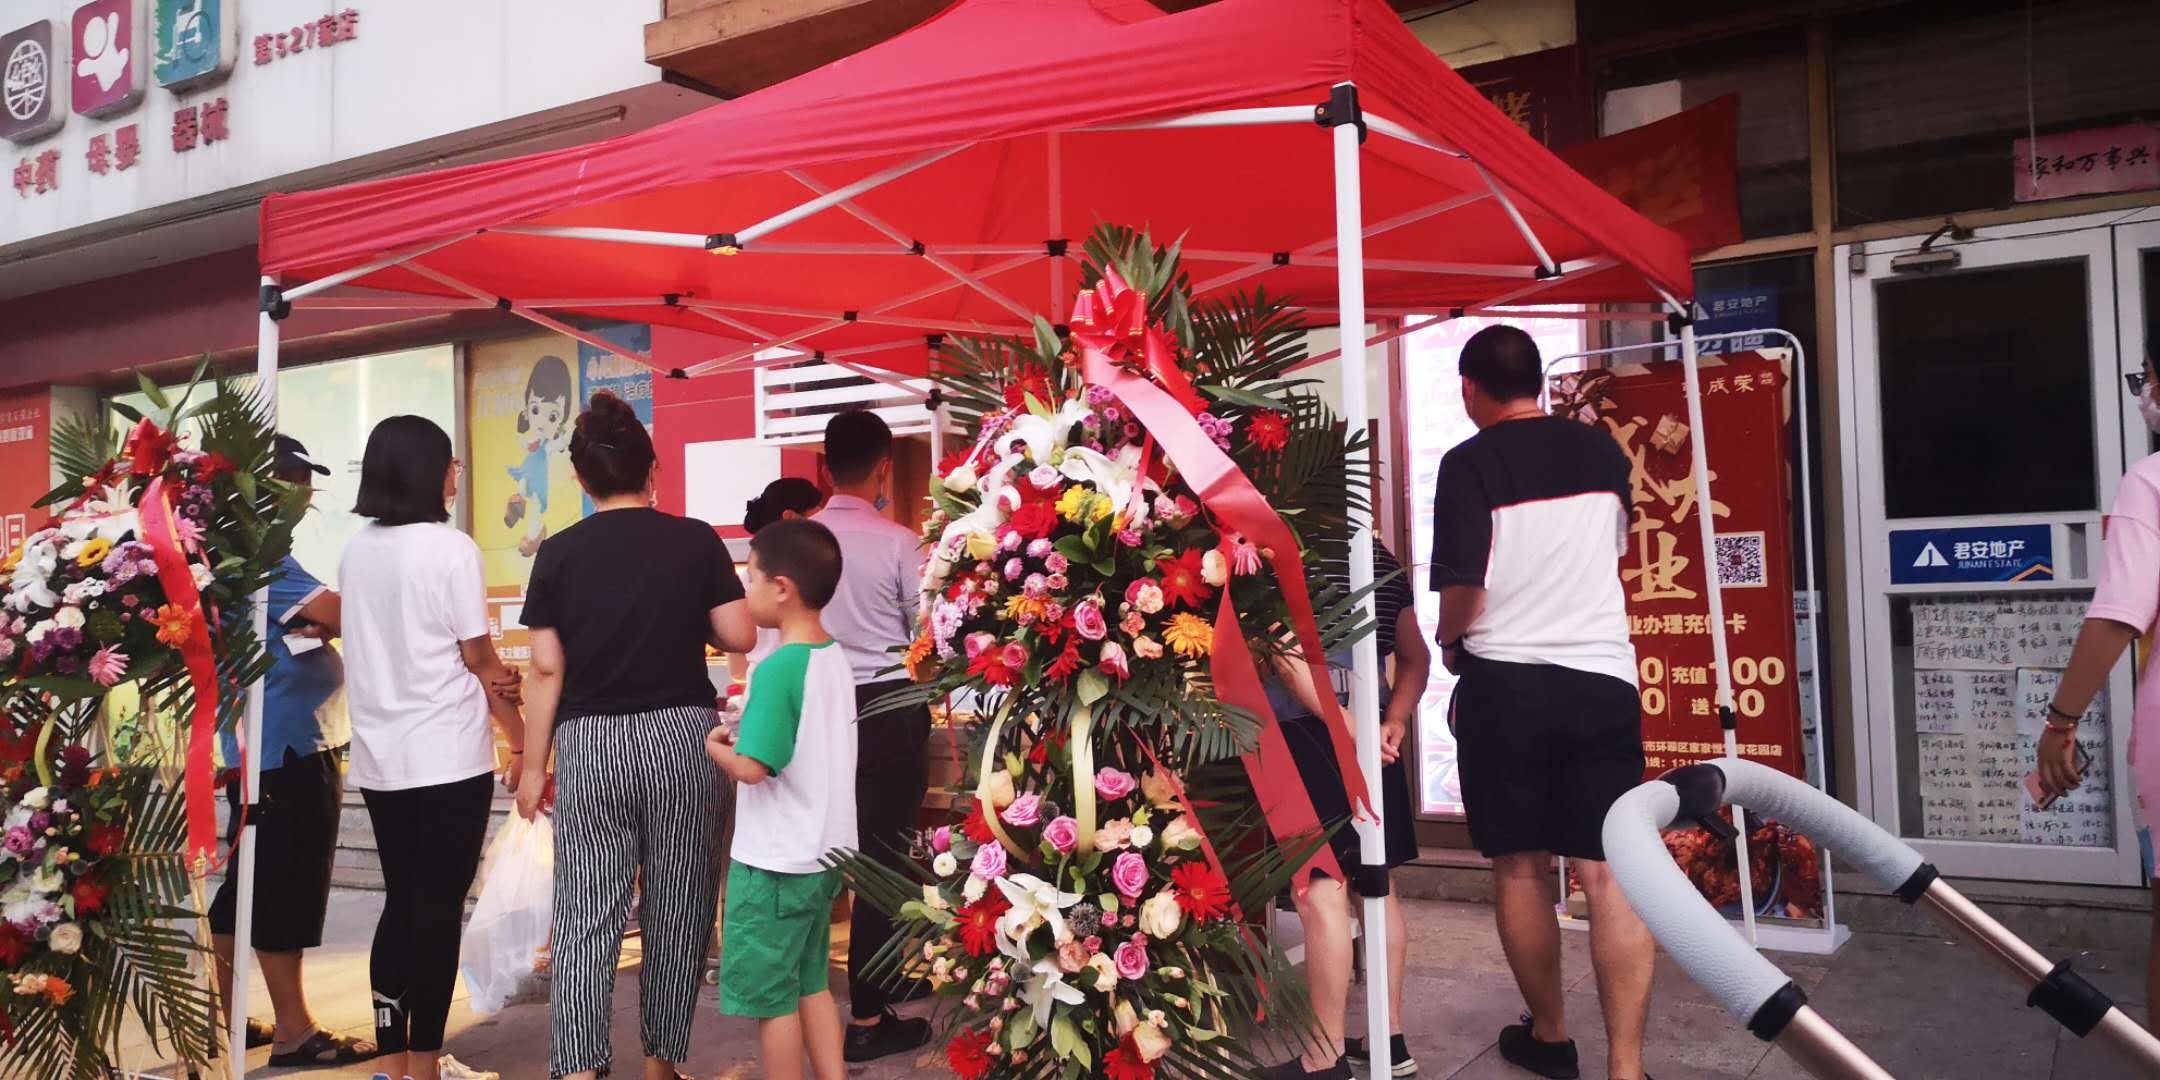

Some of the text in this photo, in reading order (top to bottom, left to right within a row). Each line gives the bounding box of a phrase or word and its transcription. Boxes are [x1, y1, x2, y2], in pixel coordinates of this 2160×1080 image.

[171, 98, 229, 153] 器械
[85, 124, 140, 175] 母婴
[2028, 145, 2150, 180] 家和万事兴
[14, 149, 61, 198] 中药
[1713, 296, 1768, 312] 君安地产
[1953, 540, 2025, 559] 君安地产
